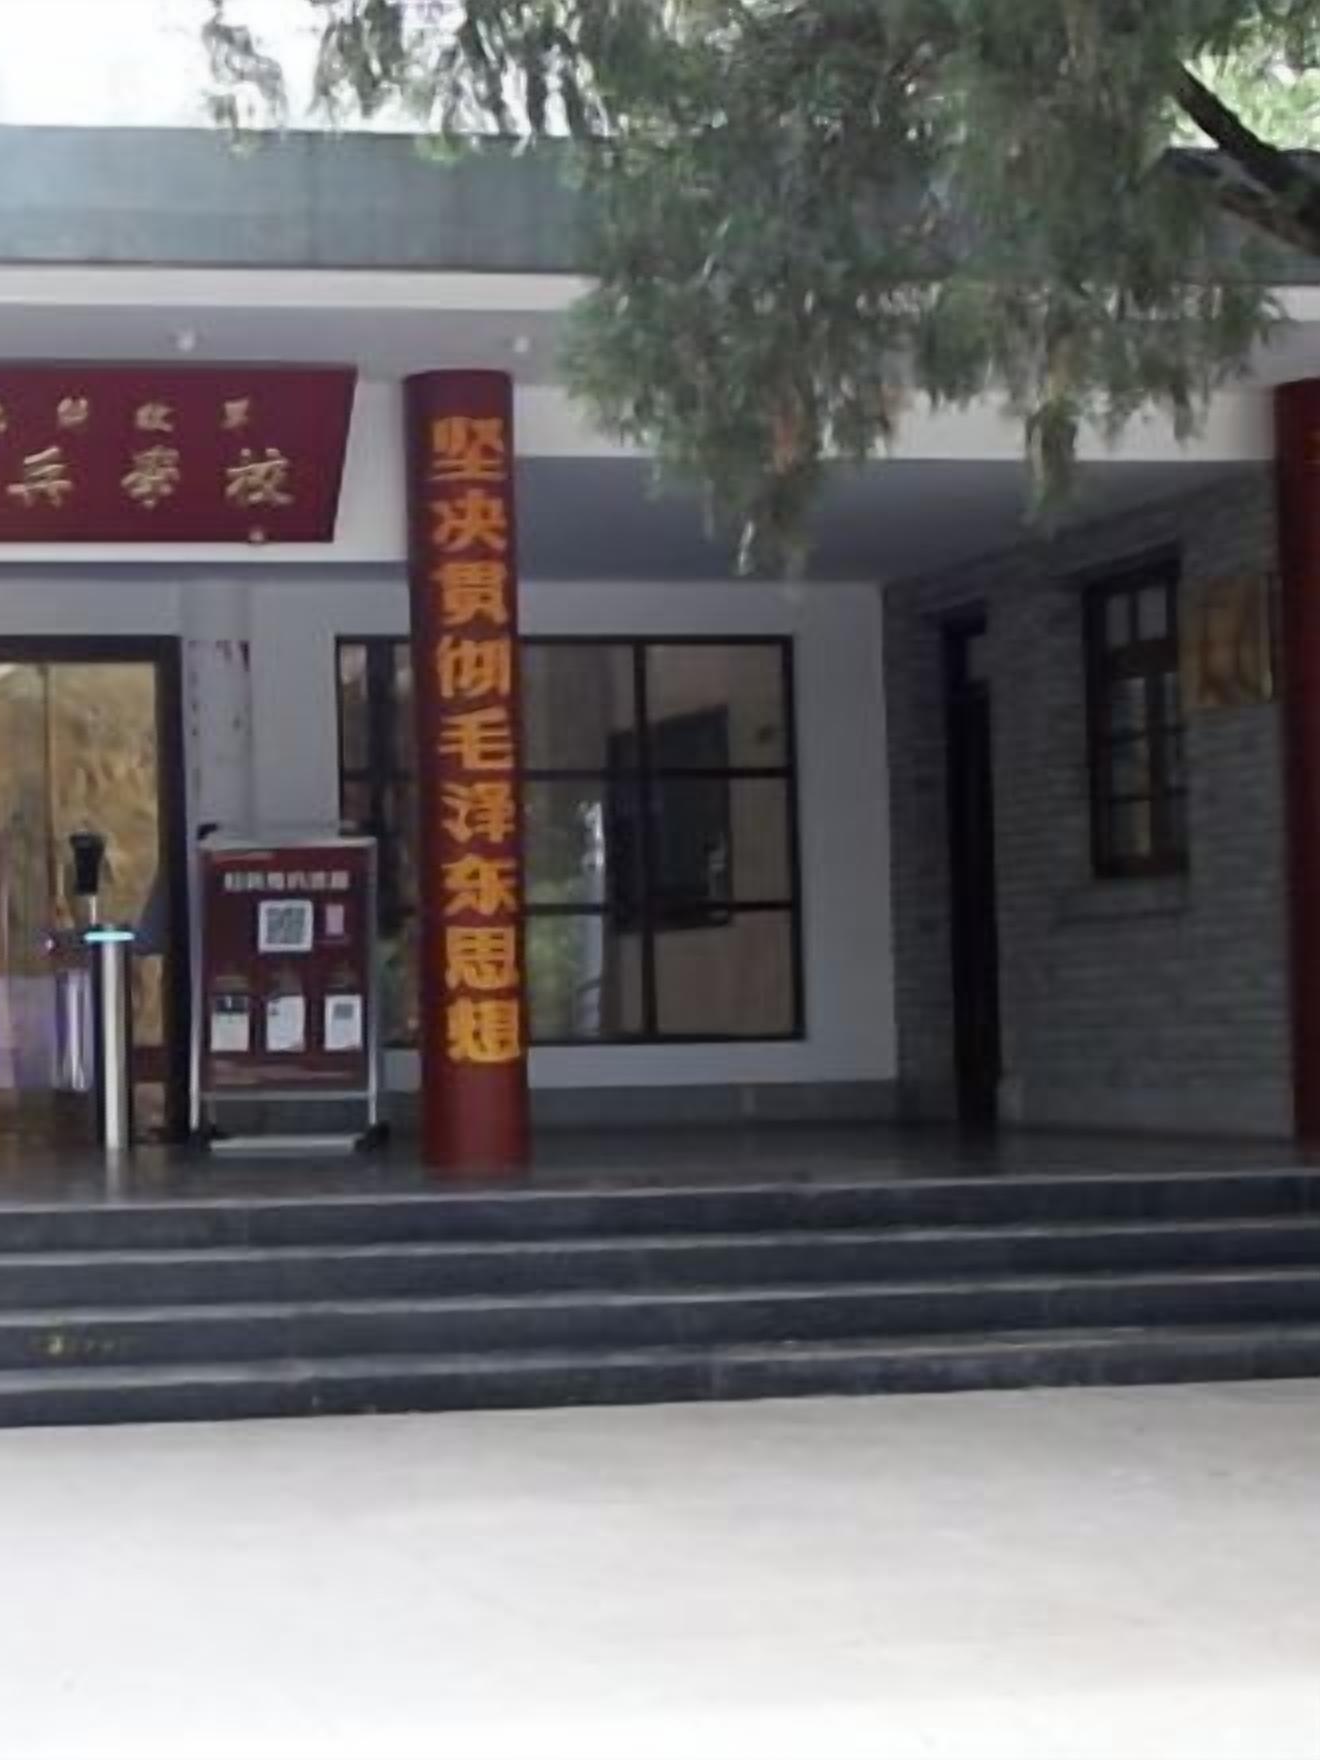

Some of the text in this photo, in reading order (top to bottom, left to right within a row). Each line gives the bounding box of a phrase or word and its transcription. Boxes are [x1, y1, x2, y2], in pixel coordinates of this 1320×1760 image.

[430, 416, 521, 1064] 坚决贯彻毛泽东思想
